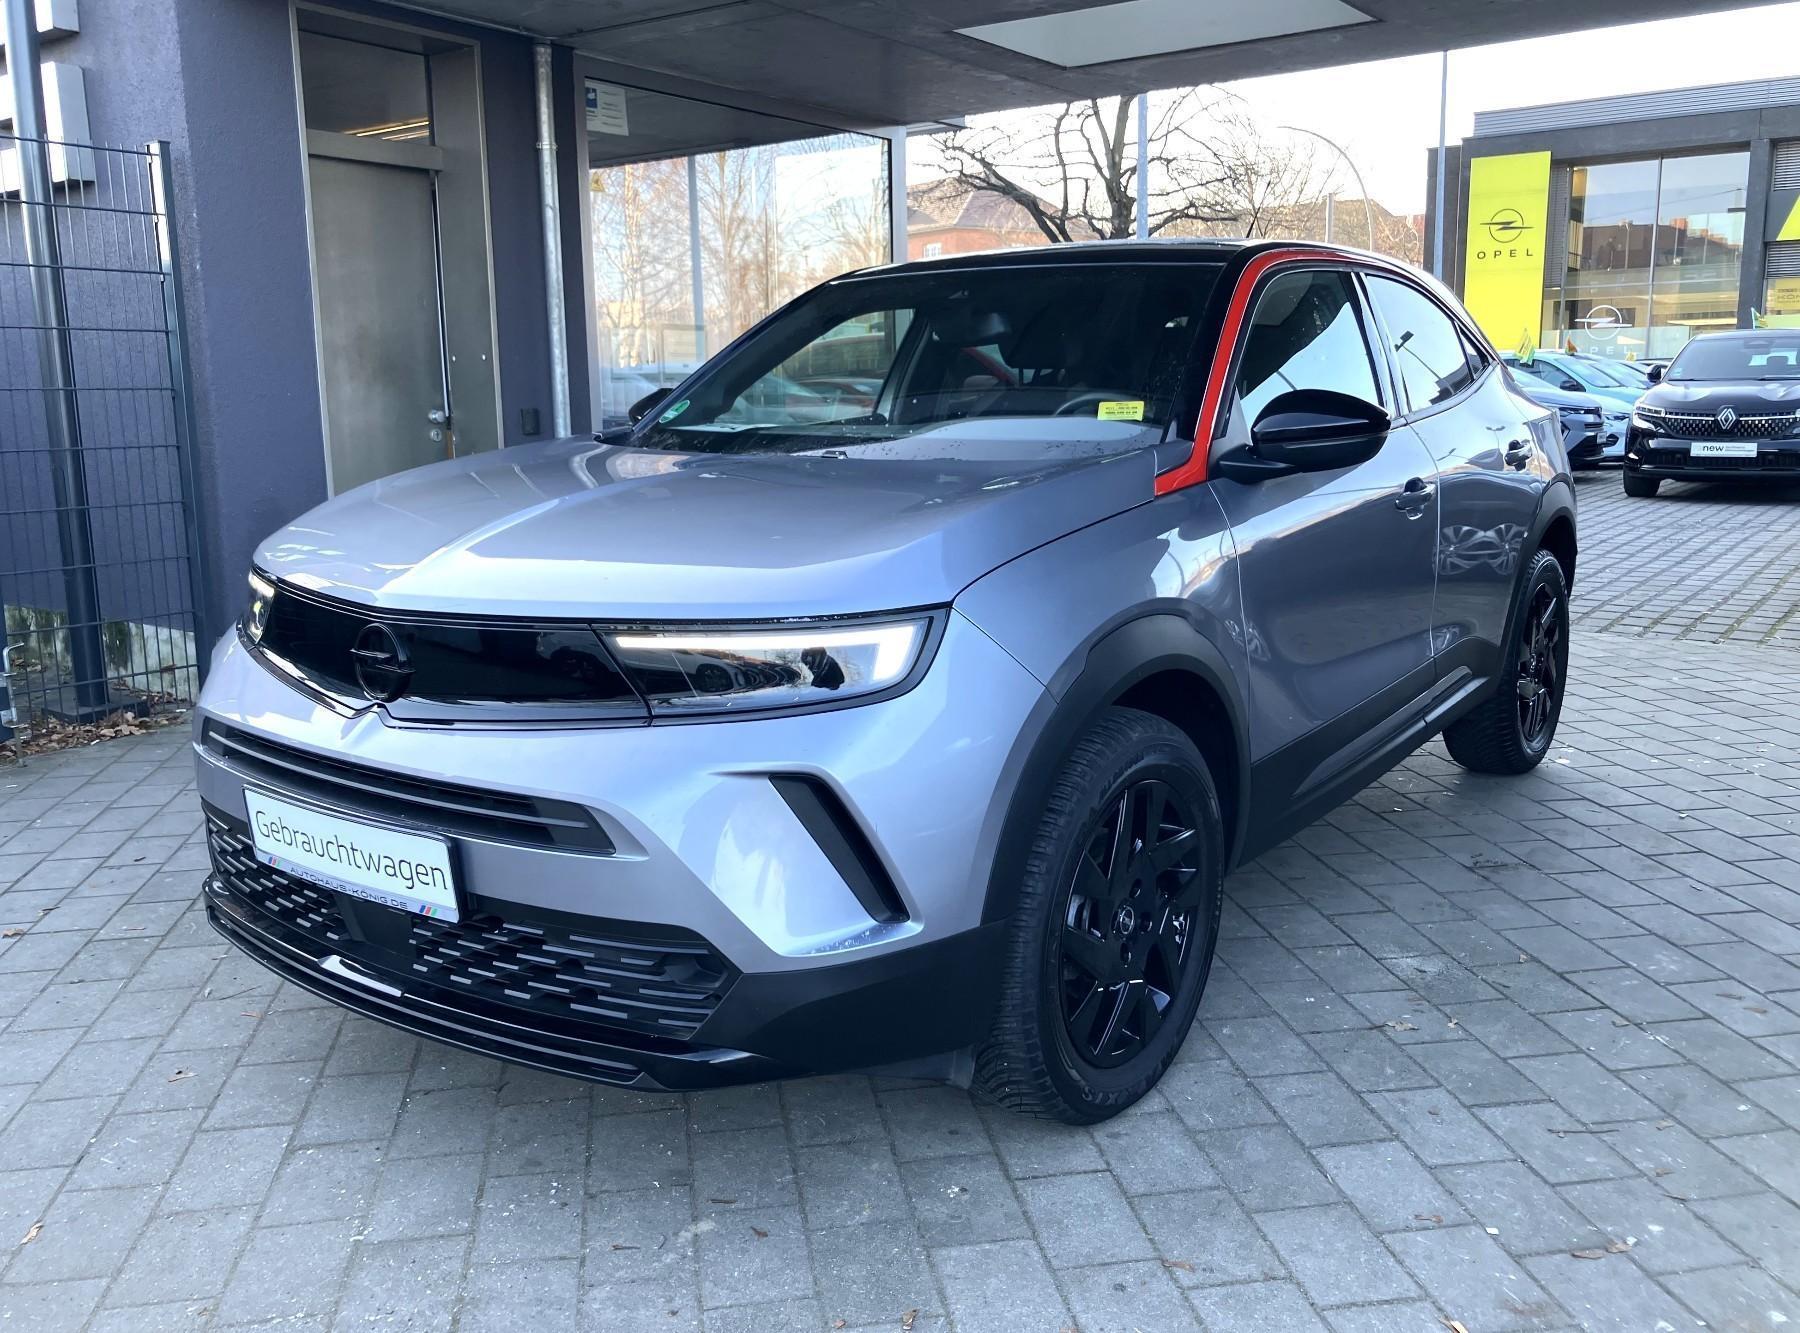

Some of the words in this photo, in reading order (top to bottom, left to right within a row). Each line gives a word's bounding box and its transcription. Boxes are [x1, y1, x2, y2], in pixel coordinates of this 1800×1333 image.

[1477, 248, 1533, 260] OPEL
[1576, 345, 1640, 356] PEL
[255, 810, 448, 890] Gebrauchtwagen
